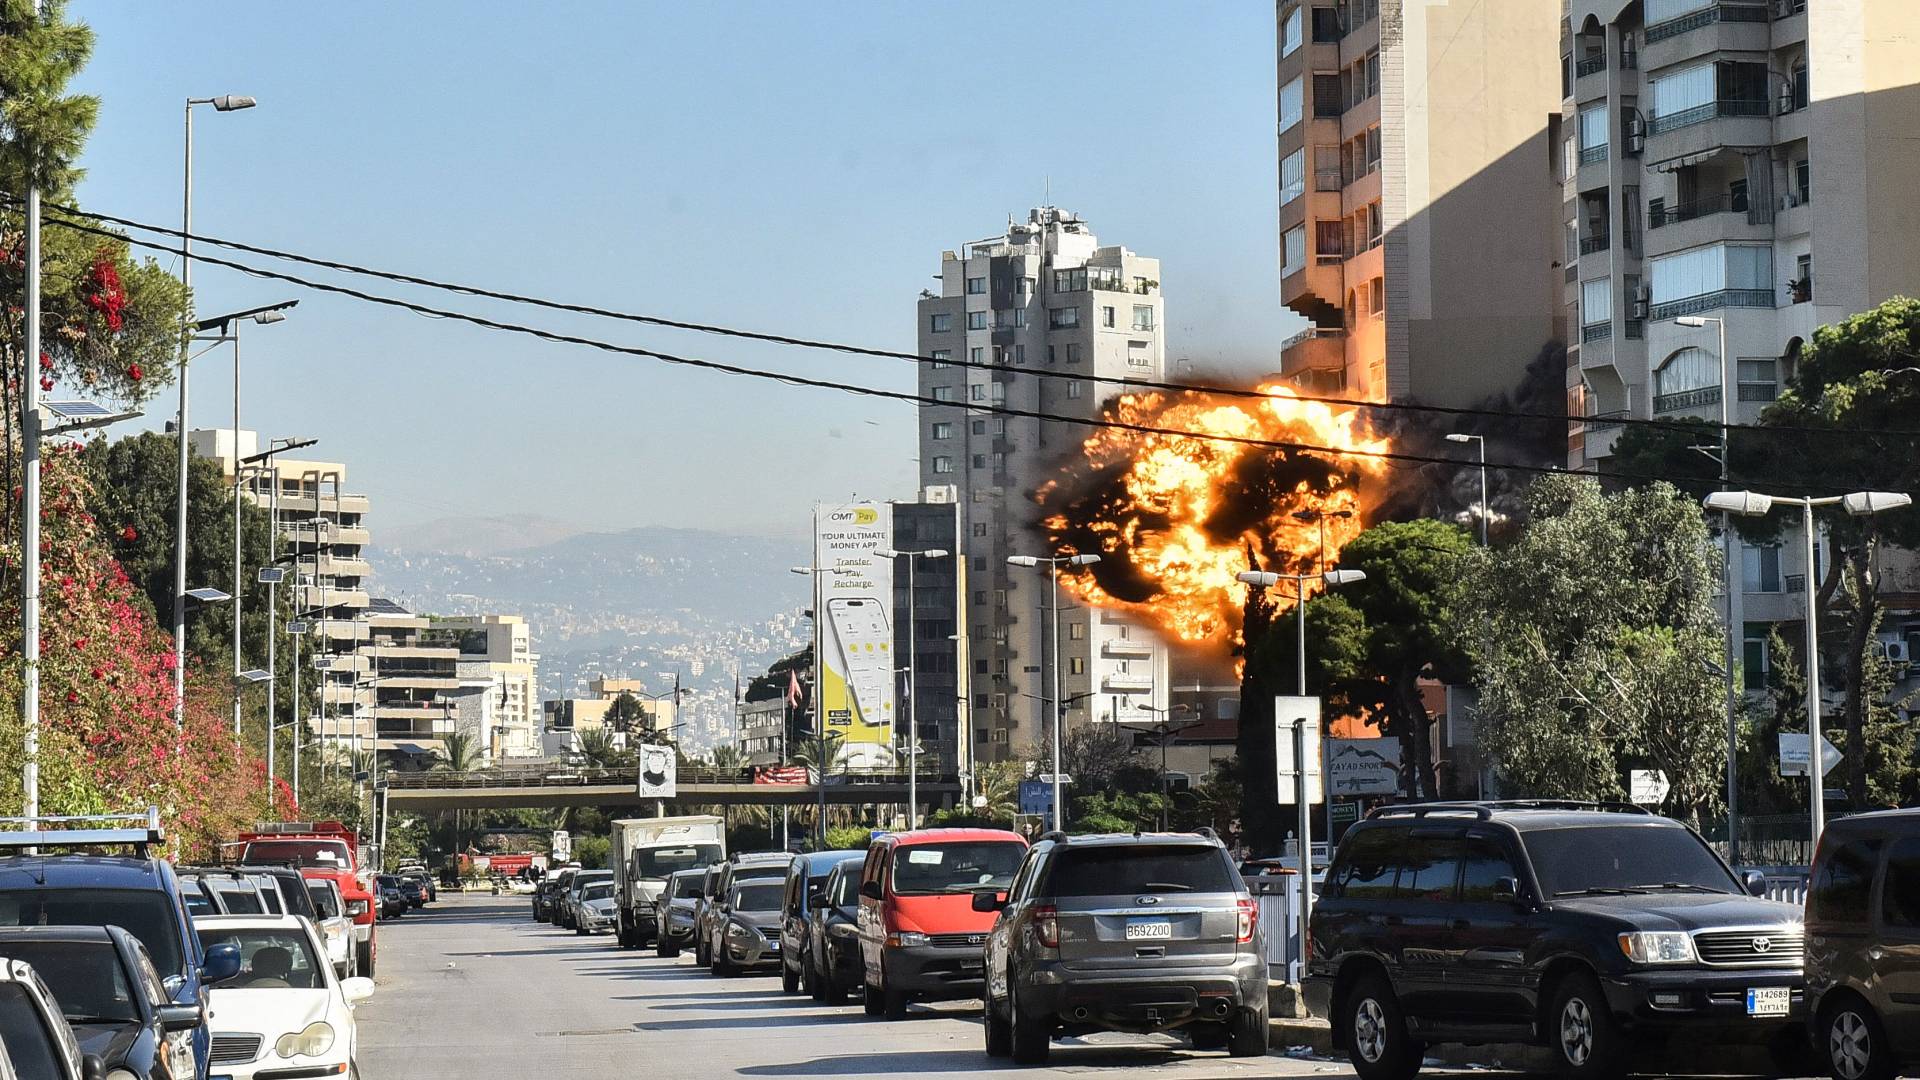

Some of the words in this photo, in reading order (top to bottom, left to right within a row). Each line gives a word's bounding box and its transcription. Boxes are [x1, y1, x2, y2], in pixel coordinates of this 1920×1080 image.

[831, 513, 853, 521] OMT
[859, 512, 874, 522] Pay
[847, 532, 886, 540] ULTIMATE
[862, 541, 878, 549] APP
[836, 558, 872, 566] Transfer.
[834, 580, 874, 589] Recharge.
[1128, 925, 1169, 937] B692200
[1761, 990, 1787, 999] 142689
